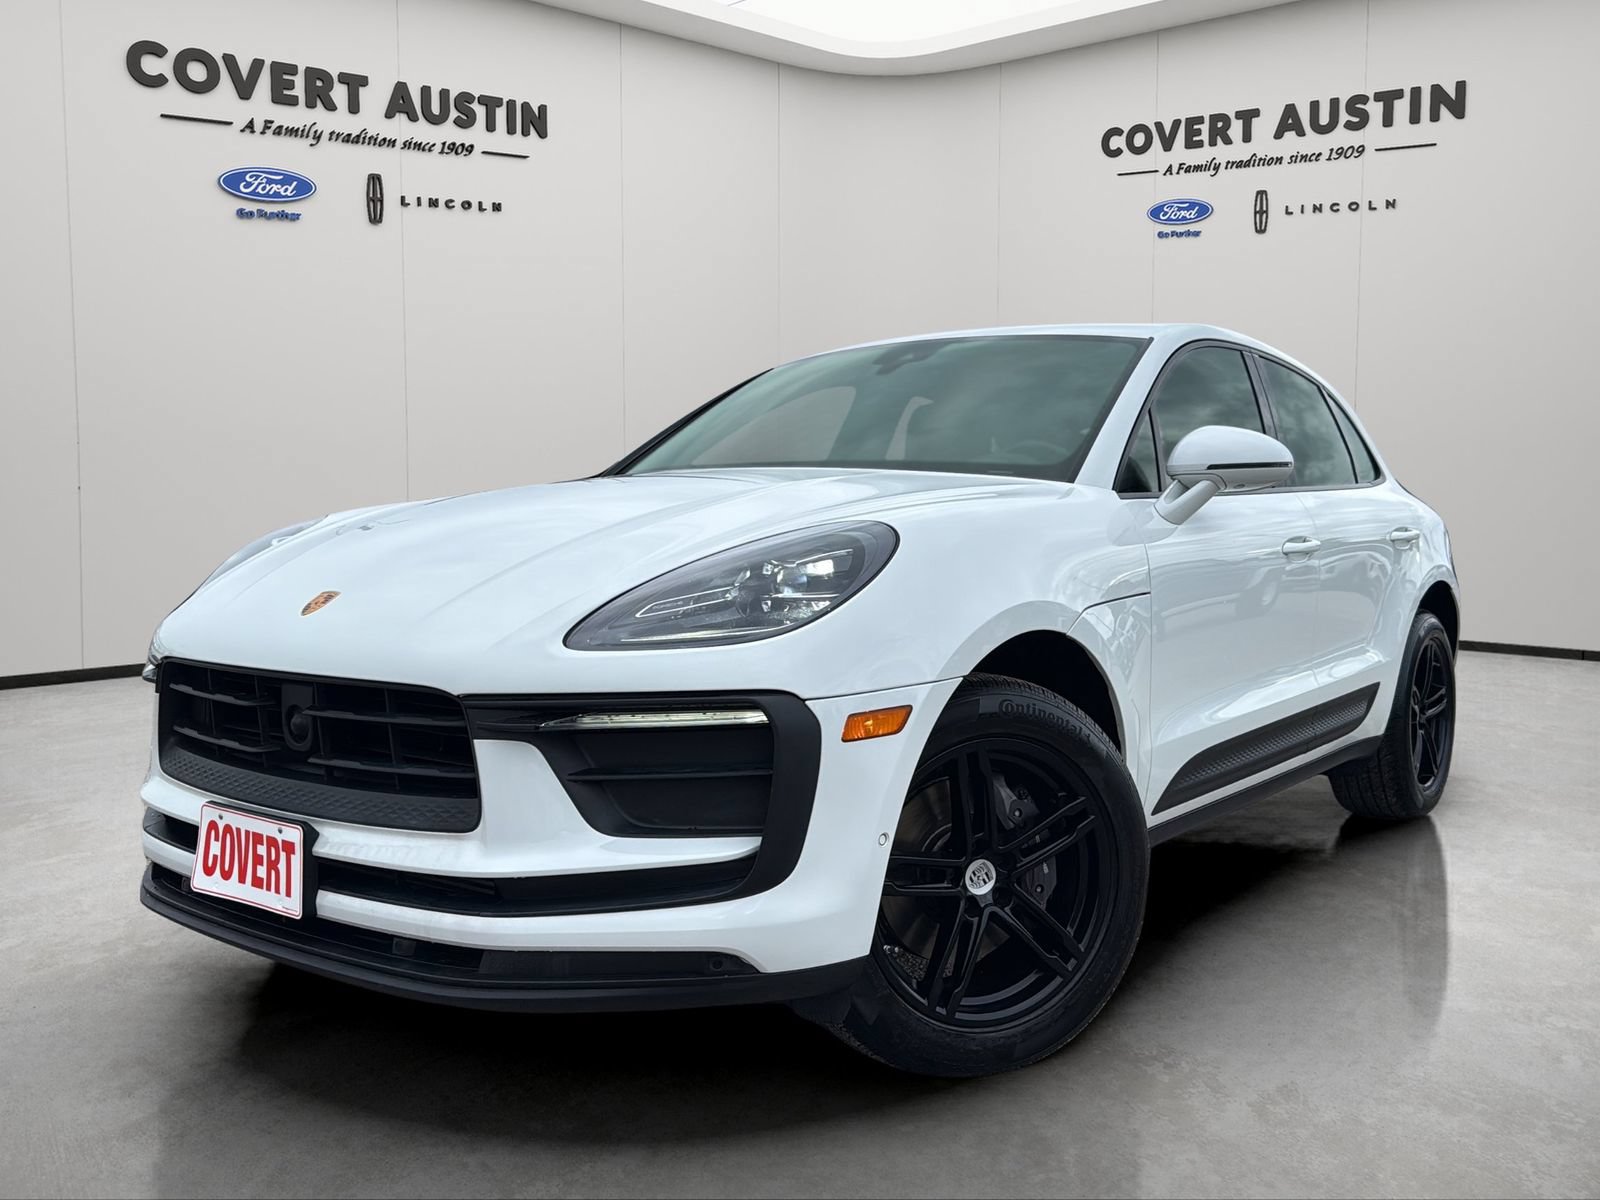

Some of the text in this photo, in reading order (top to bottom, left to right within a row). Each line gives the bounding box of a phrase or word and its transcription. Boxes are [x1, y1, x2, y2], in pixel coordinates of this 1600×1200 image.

[126, 40, 549, 140] COVERT AUSTIN
[1101, 80, 1467, 159] COVERT AUSTIN
[240, 118, 475, 157] A Family tradition since 1909
[1163, 144, 1366, 177] A Family tradition since 1909
[239, 171, 298, 199] Ford
[236, 208, 255, 219] Go
[400, 195, 503, 213] LINCOLN
[1159, 202, 1200, 220] Ford
[1284, 198, 1398, 216] LINCOLN
[1157, 231, 1170, 239] Go
[1001, 700, 1083, 738] Continental
[202, 819, 296, 898] COVERT
